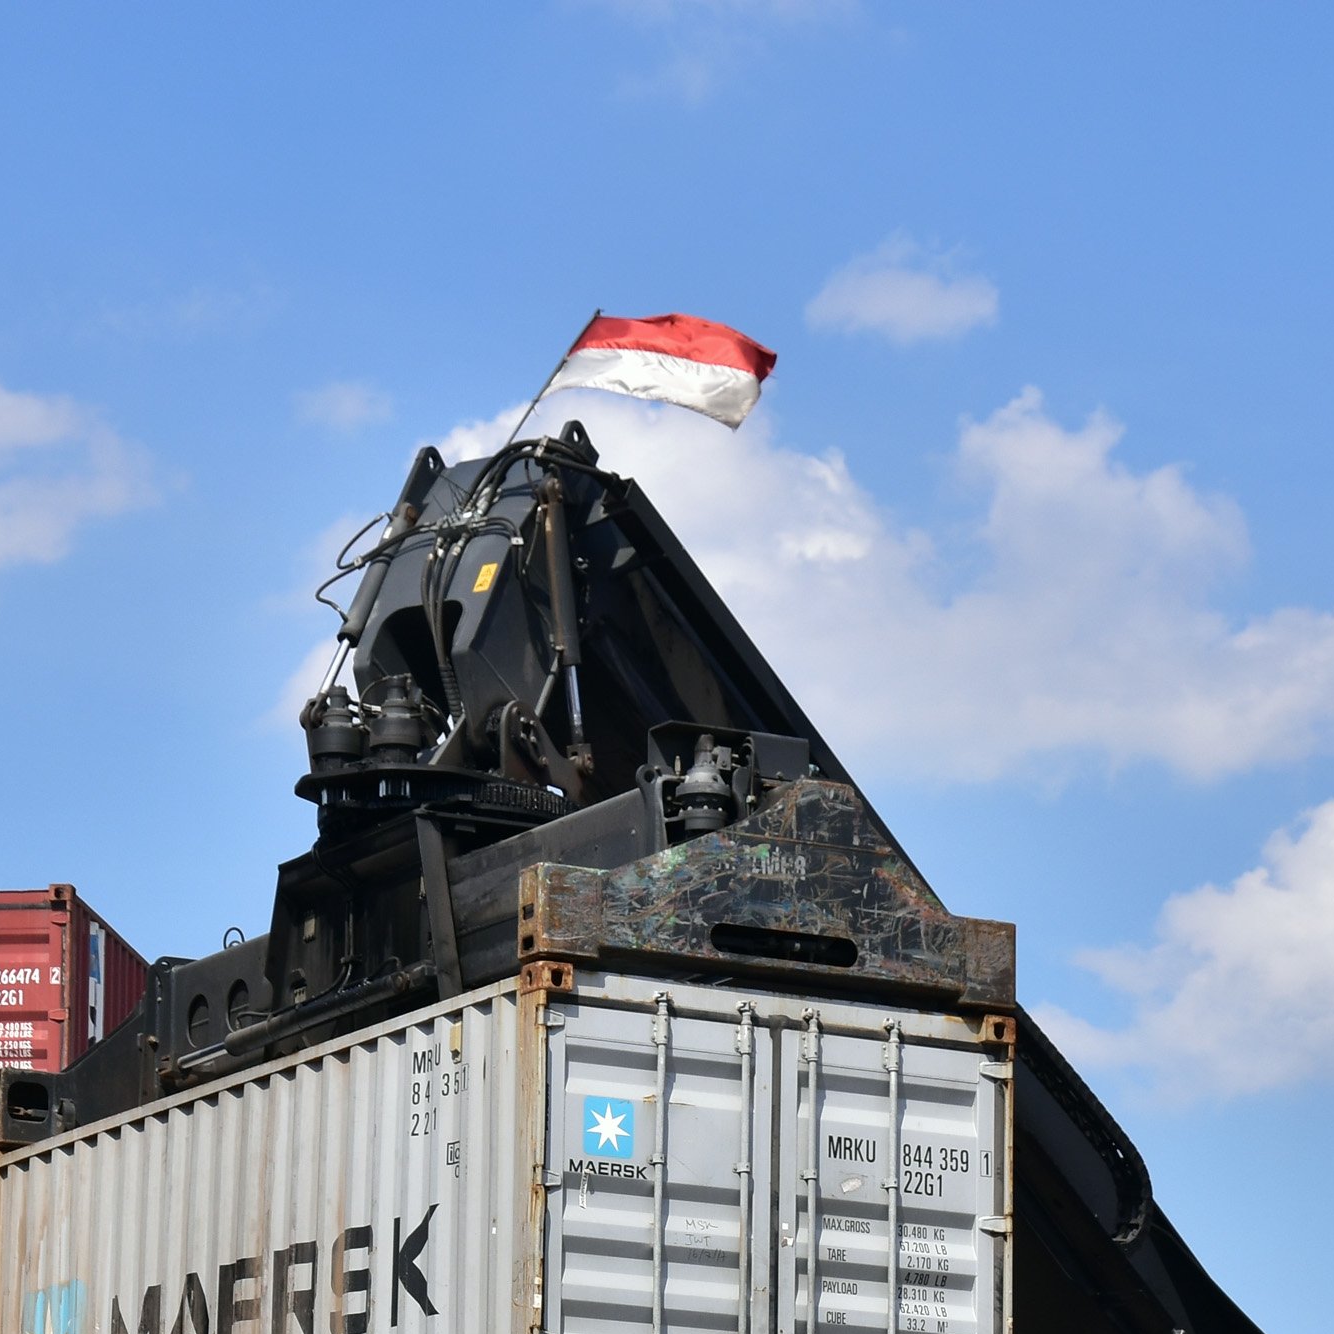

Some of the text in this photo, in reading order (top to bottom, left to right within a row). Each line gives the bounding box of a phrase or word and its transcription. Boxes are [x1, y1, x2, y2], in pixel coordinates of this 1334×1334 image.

[51, 968, 59, 984] 2
[827, 1135, 990, 1175] MRKU 844 359 1
[569, 1158, 648, 1180] MAERSK
[904, 1170, 943, 1197] 22G1
[898, 1225, 927, 1239] 30.480
[934, 1228, 945, 1241] KG
[935, 1244, 947, 1255] LB
[827, 1248, 949, 1271] TARE 2.170 KG
[904, 1272, 947, 1286] 4.780 LB
[822, 1280, 945, 1303] PAYLOAD 28.310 KG
[935, 1306, 947, 1317] LB
[826, 1312, 925, 1331] CUBE 33.2
